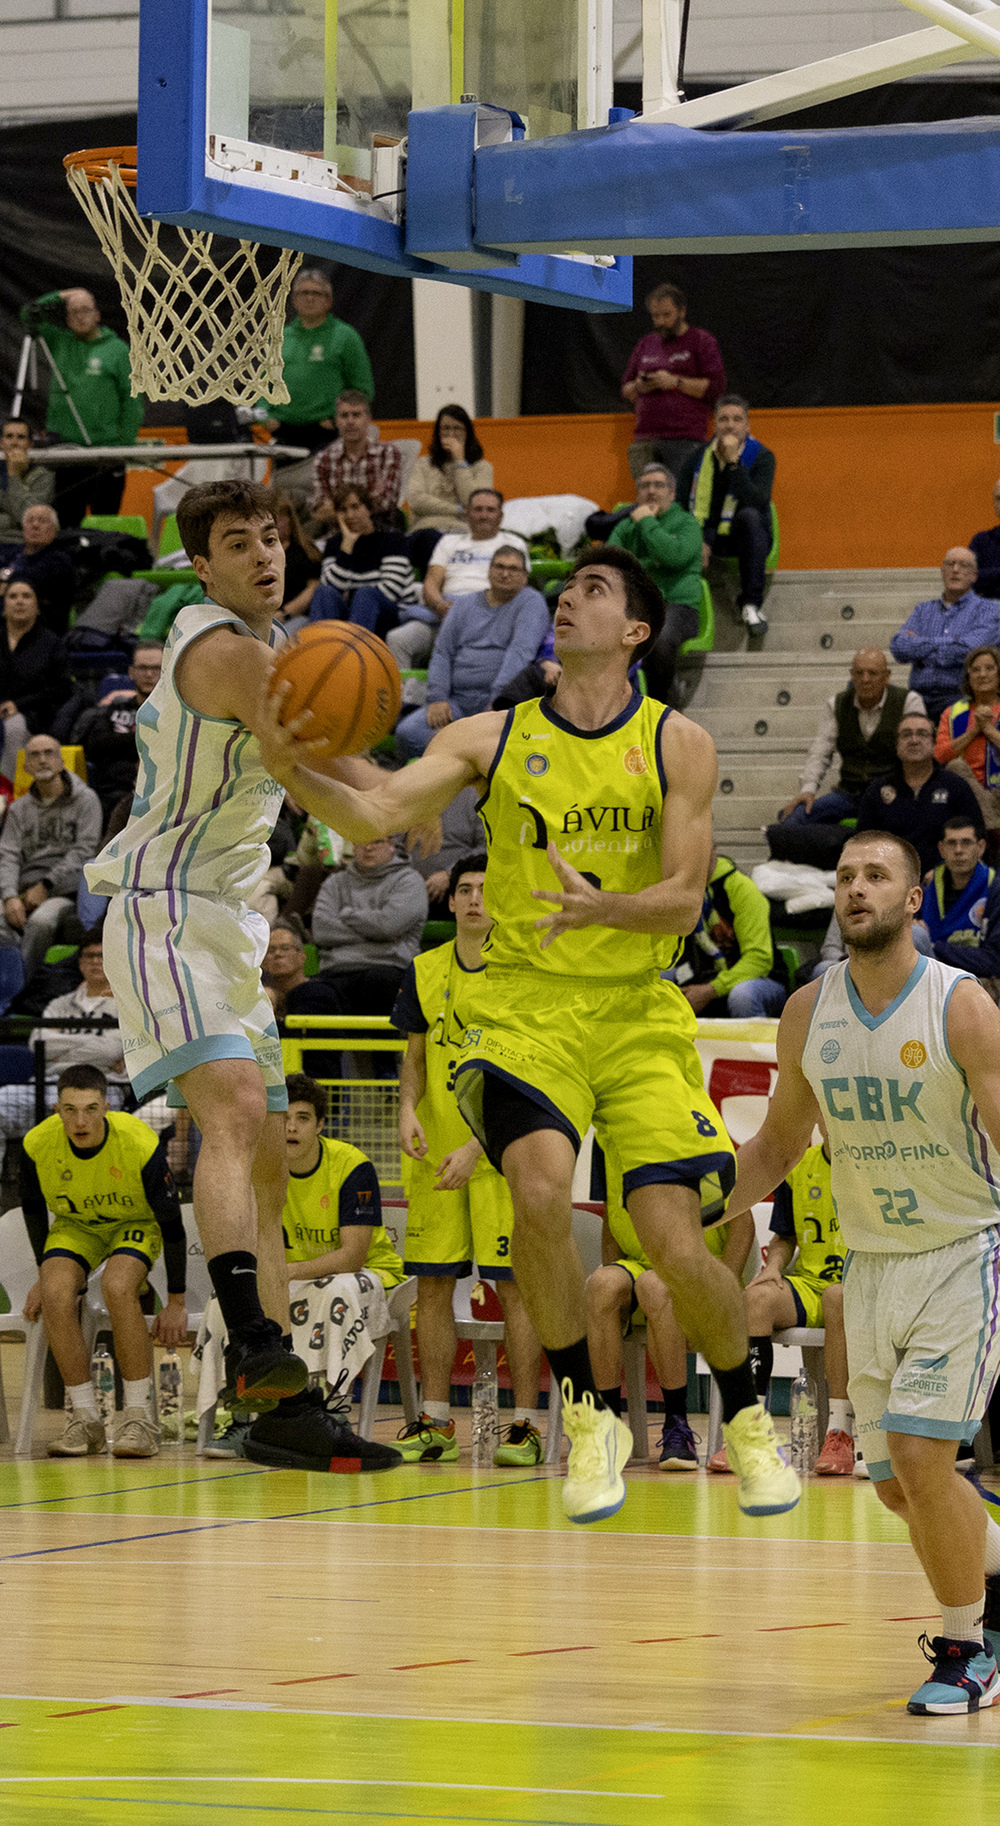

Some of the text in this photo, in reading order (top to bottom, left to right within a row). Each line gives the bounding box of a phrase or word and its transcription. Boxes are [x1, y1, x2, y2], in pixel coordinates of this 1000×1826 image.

[560, 803, 654, 834] ÁVILA
[820, 1076, 927, 1124] CBK
[690, 1110, 718, 1137] 8
[900, 1143, 950, 1162] FINO
[83, 1192, 134, 1210] ÁVILA
[872, 1188, 925, 1227] 22
[122, 1229, 144, 1243] 10
[496, 1235, 510, 1257] 3
